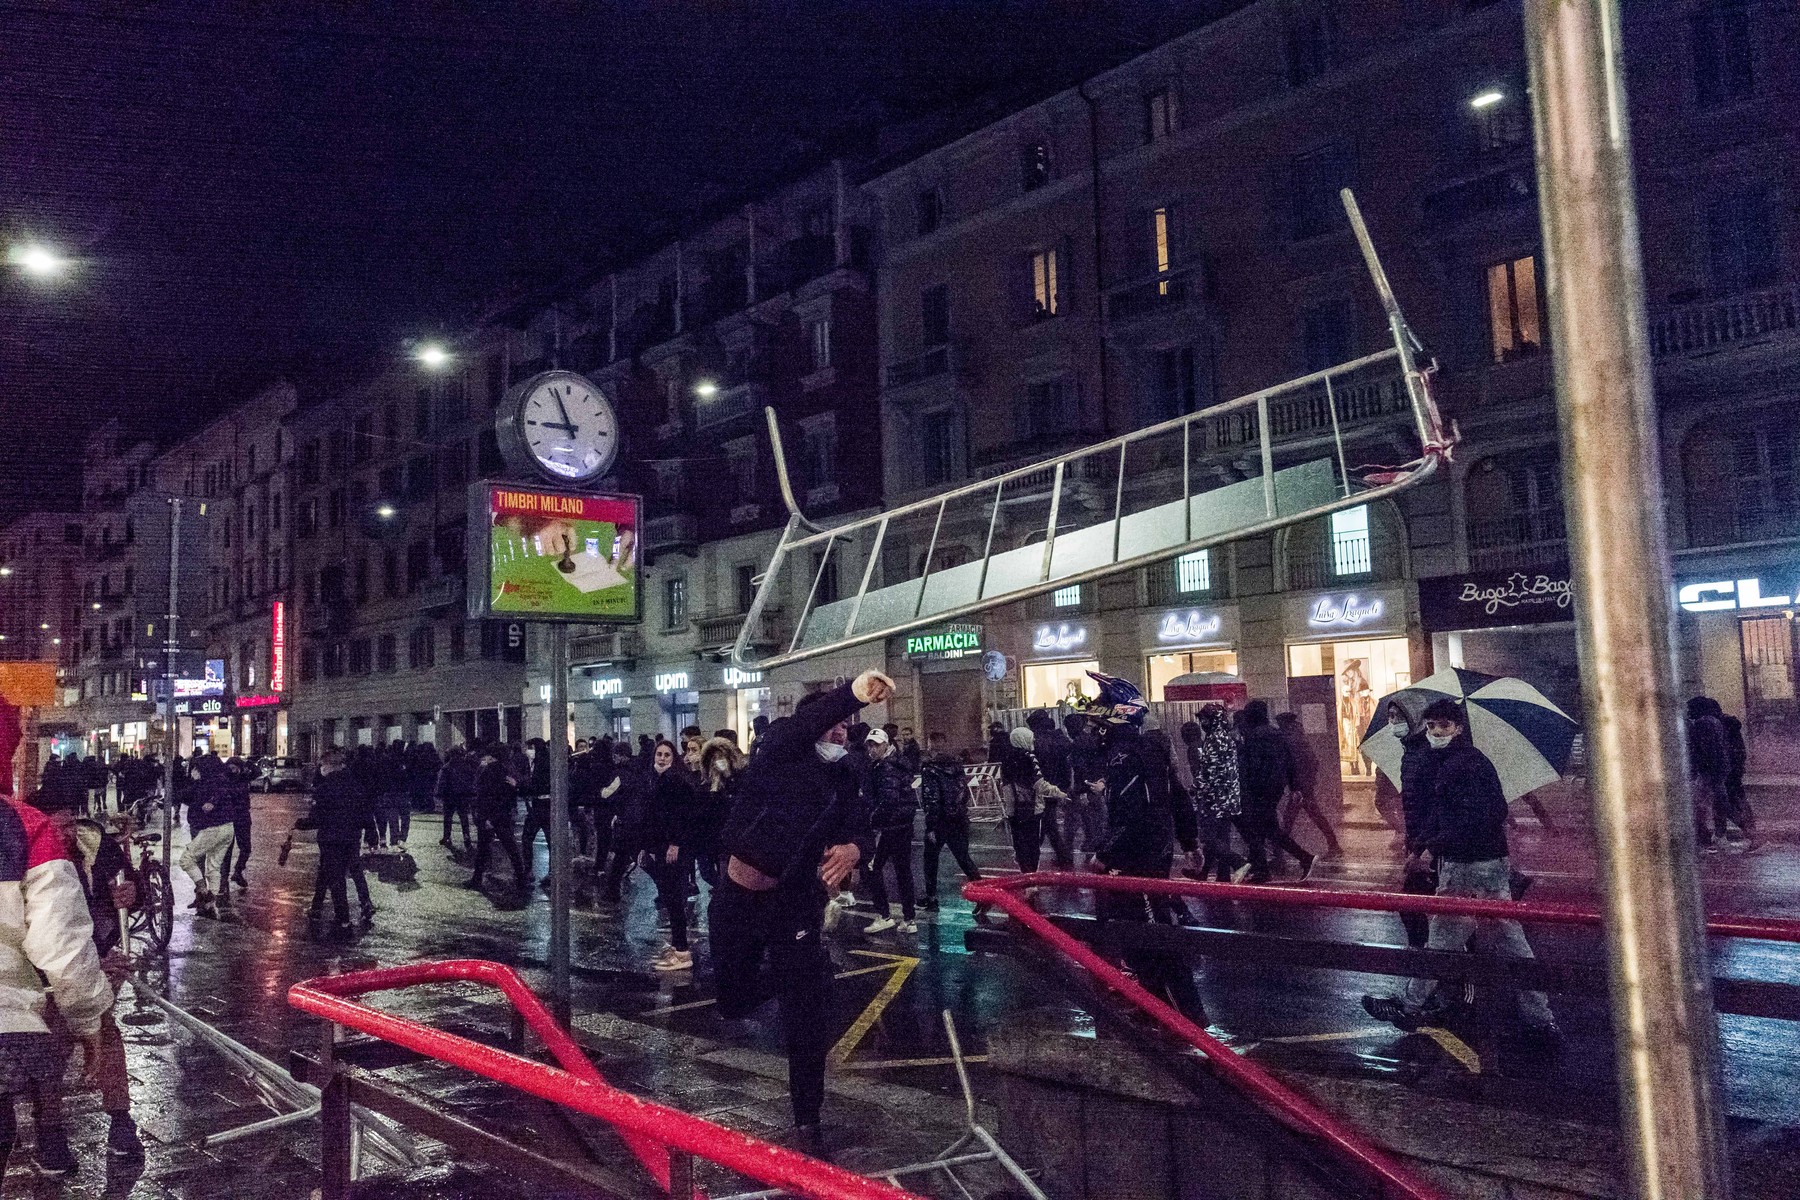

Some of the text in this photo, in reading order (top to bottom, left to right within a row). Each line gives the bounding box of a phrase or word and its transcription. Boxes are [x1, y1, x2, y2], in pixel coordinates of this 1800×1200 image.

[497, 491, 584, 514] TIMBRI MILANO
[1458, 575, 1573, 614] Buga Bag
[1679, 578, 1800, 612] CL
[907, 633, 979, 653] FARMACIA
[927, 649, 963, 660] BALDINI
[592, 678, 622, 700] upim
[655, 672, 688, 694] upim
[203, 699, 221, 711] elfo
